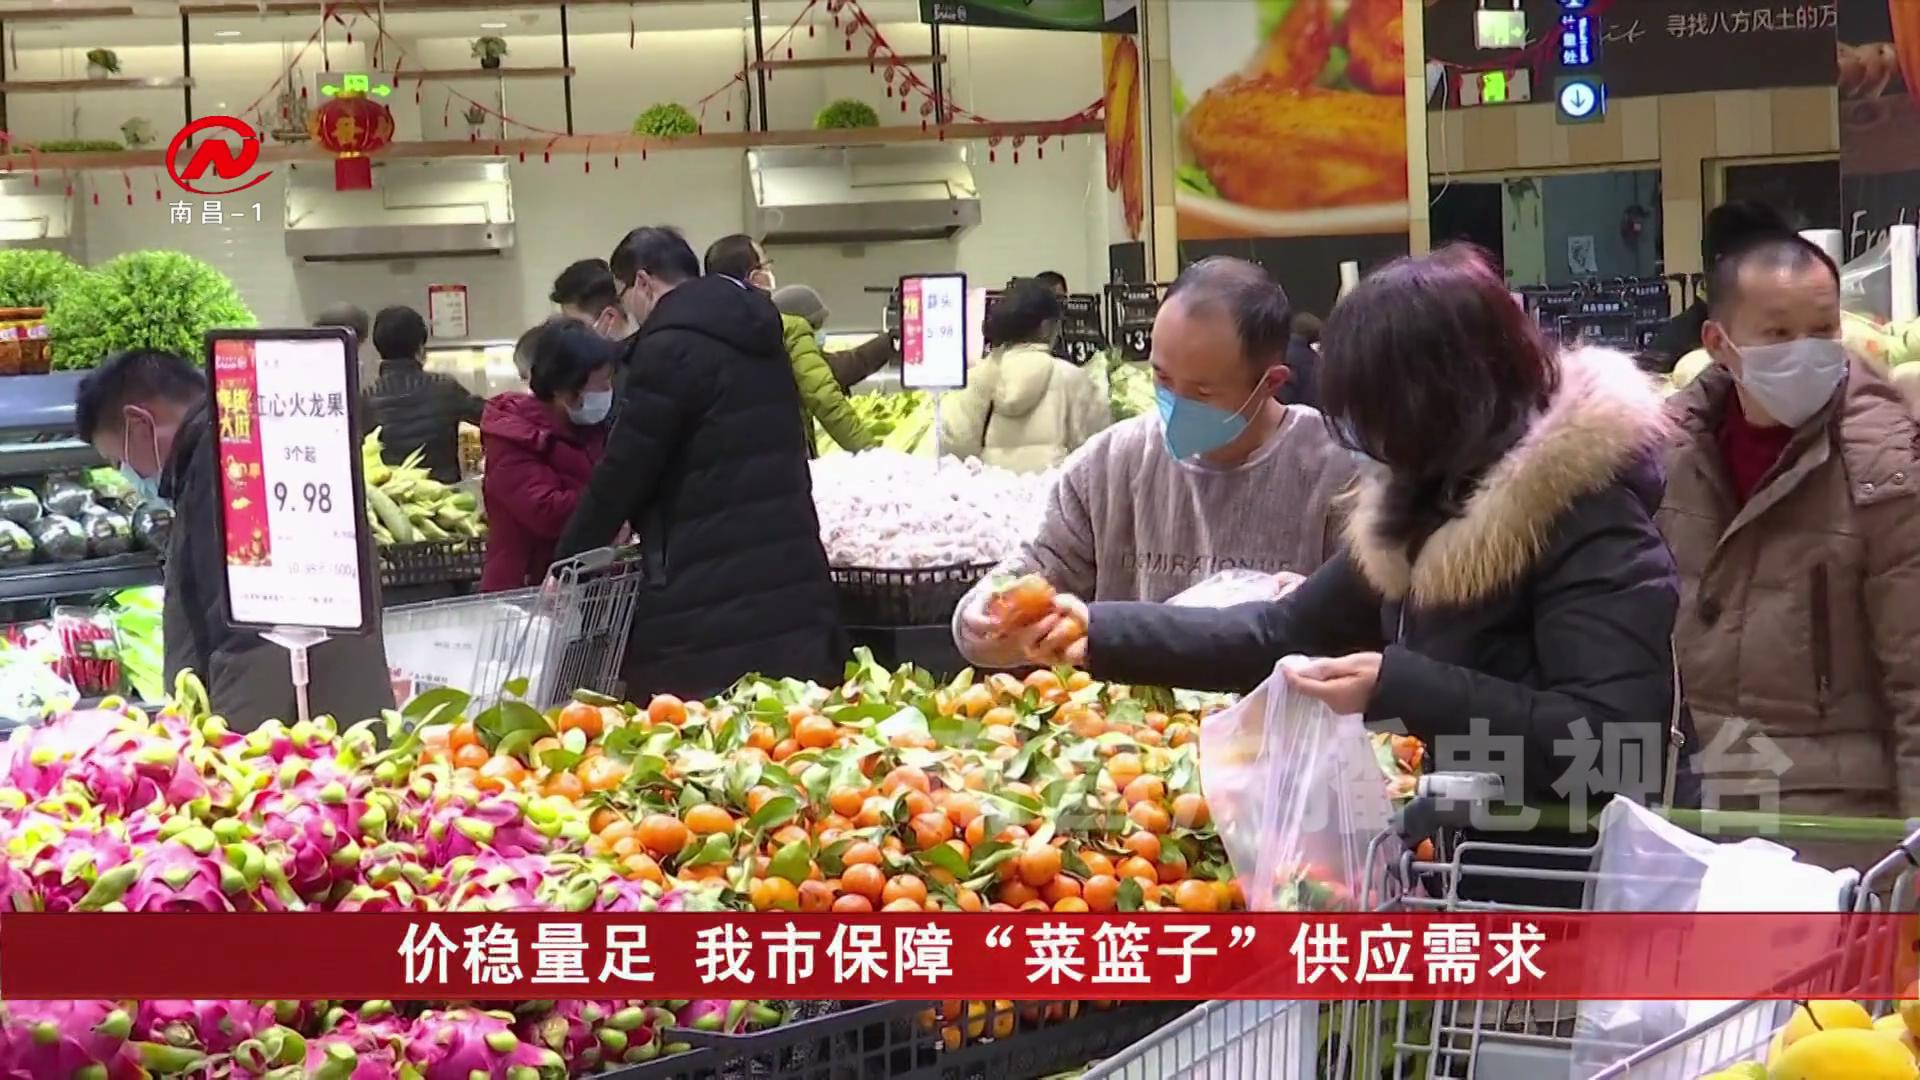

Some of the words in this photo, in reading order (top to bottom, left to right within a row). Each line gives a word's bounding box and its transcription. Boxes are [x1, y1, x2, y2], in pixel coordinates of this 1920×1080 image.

[1666, 5, 1838, 38] 寻找八方风土的万
[273, 481, 333, 514] 9.98
